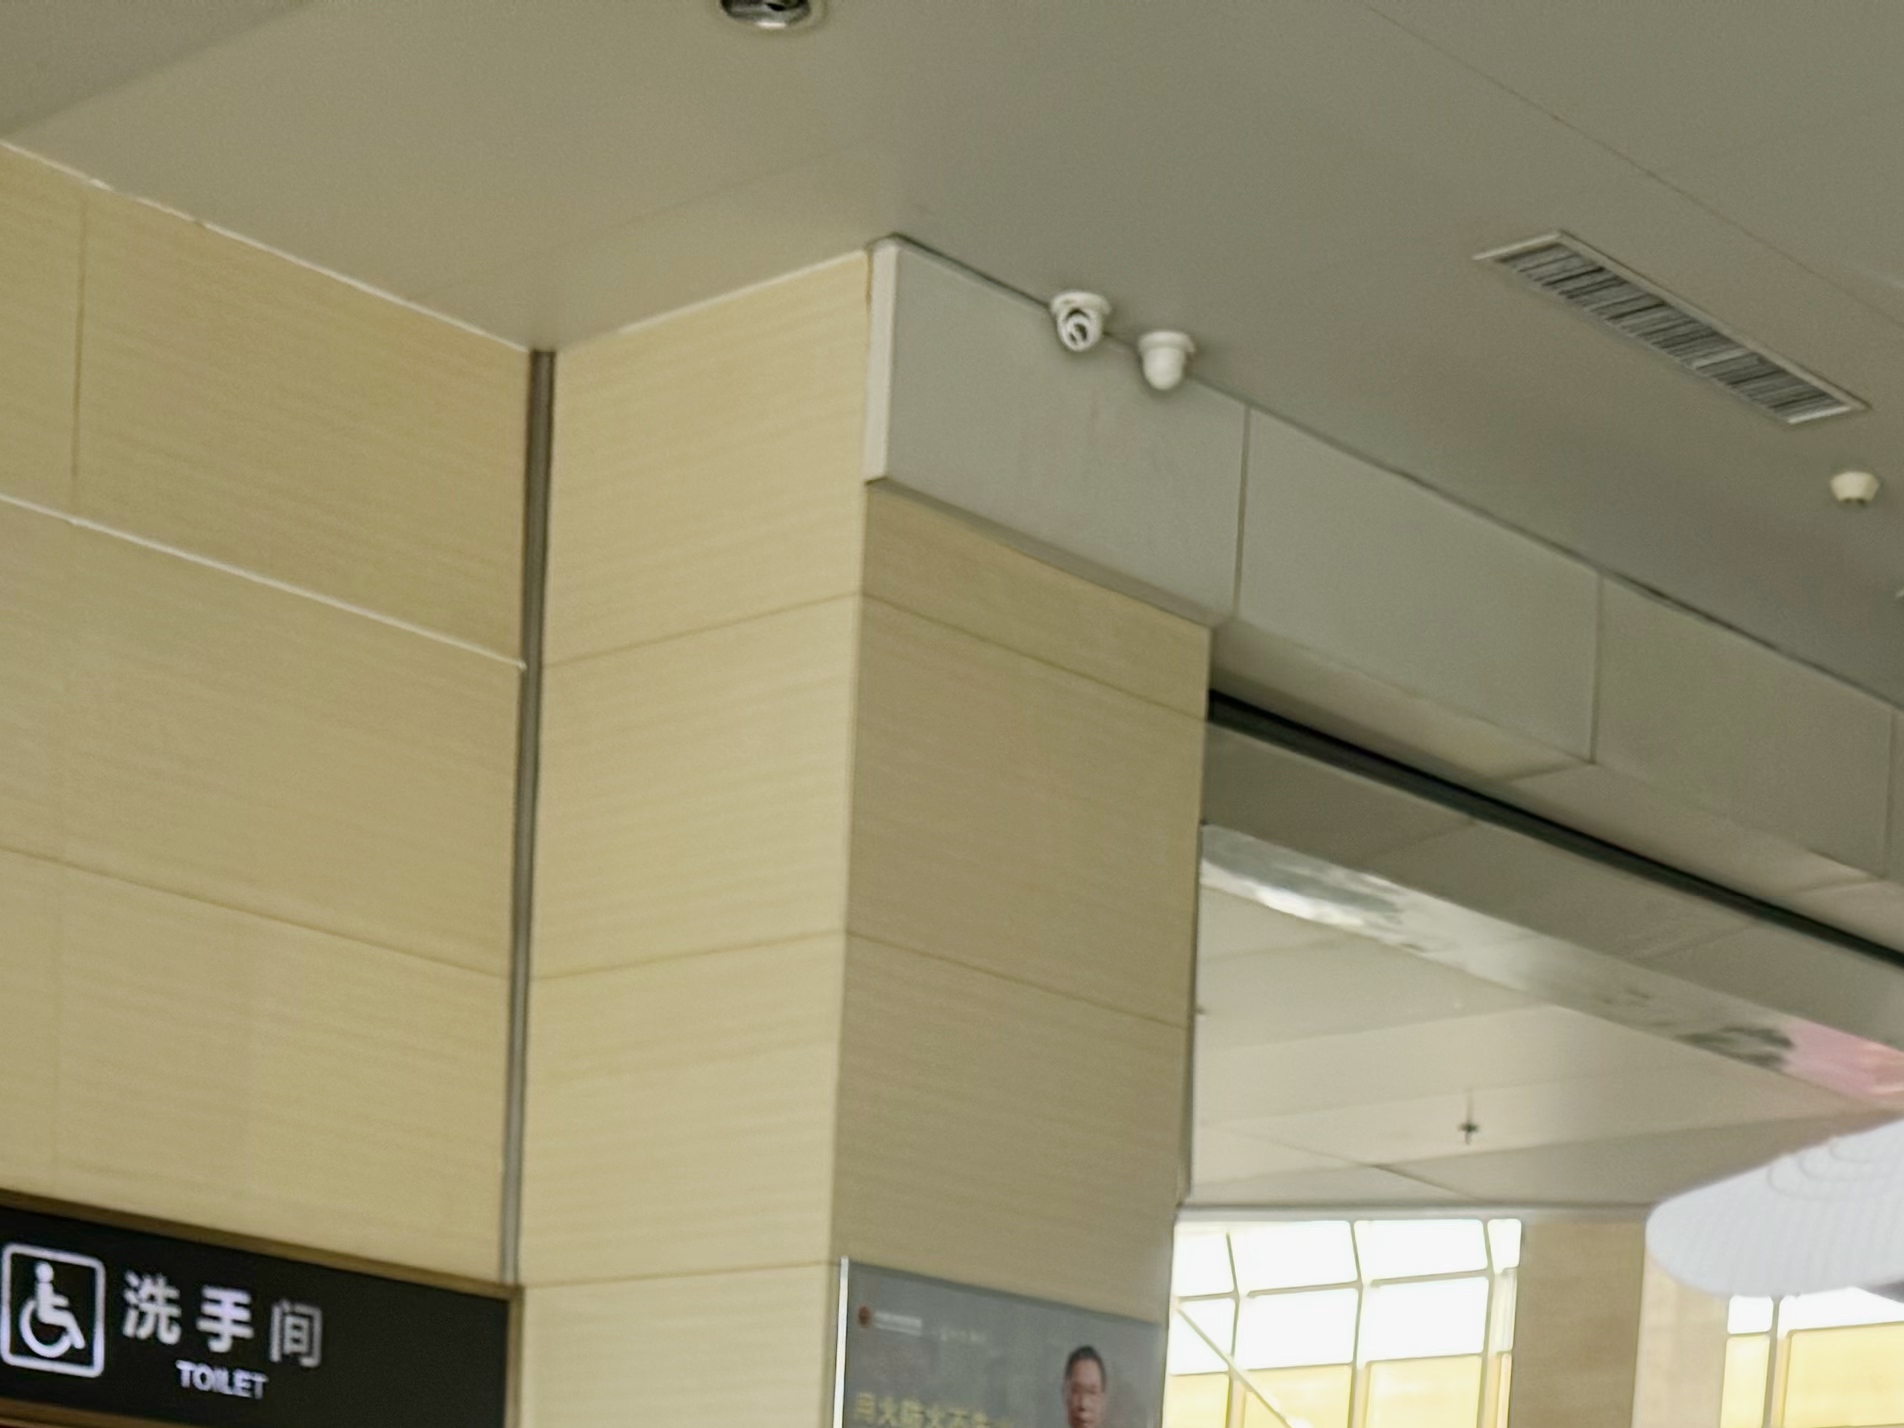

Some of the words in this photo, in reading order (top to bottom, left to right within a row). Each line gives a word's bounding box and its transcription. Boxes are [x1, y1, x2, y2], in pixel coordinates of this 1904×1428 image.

[121, 1269, 323, 1368] 洗手间
[175, 1359, 269, 1400] TOILET
